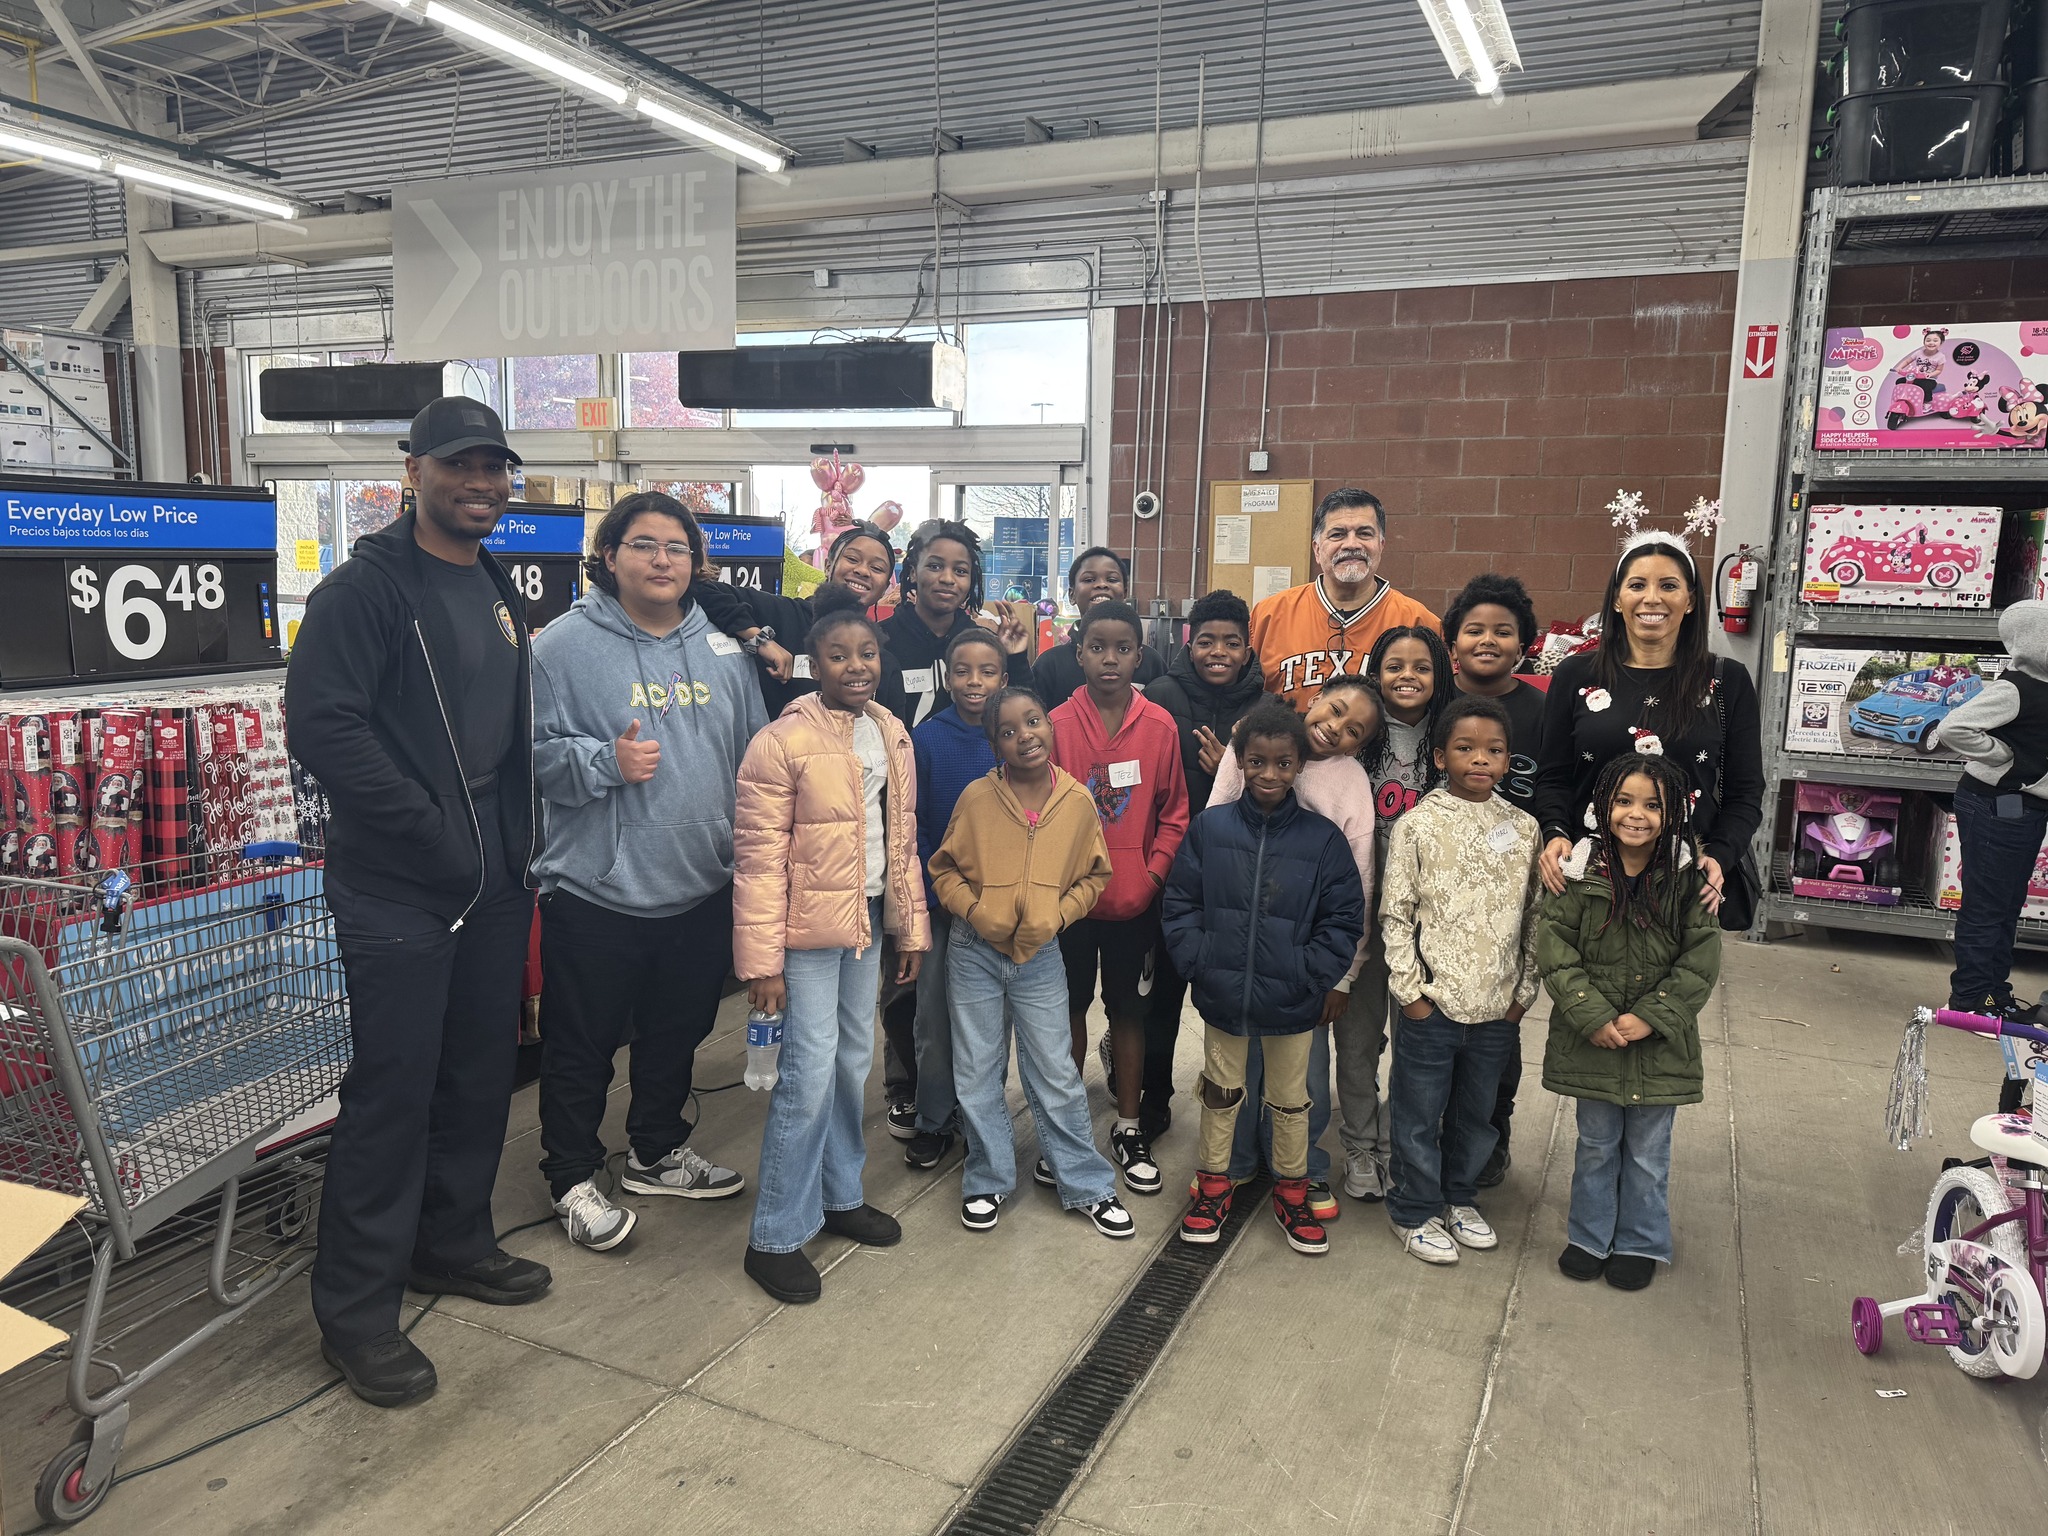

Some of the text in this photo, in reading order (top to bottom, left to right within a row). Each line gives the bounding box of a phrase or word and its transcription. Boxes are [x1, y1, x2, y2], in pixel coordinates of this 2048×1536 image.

[498, 170, 708, 262] ENJOY THE
[499, 255, 714, 341] OUTDOORS
[1829, 346, 1877, 360] MINNIE
[582, 402, 608, 427] EXIT
[7, 500, 198, 526] Everyday Low Price
[9, 525, 149, 539] Precios bajos todos los días
[492, 519, 536, 534] ow Price
[715, 528, 731, 540] Low
[732, 528, 751, 541] Price
[1957, 593, 1985, 601] RFID
[1798, 660, 1856, 672] FROZEN II
[1800, 682, 1842, 692] 12 VOLT
[630, 671, 711, 718] AC/DC
[1788, 729, 1820, 737] Mercedes
[1088, 767, 1108, 777] SPIDE
